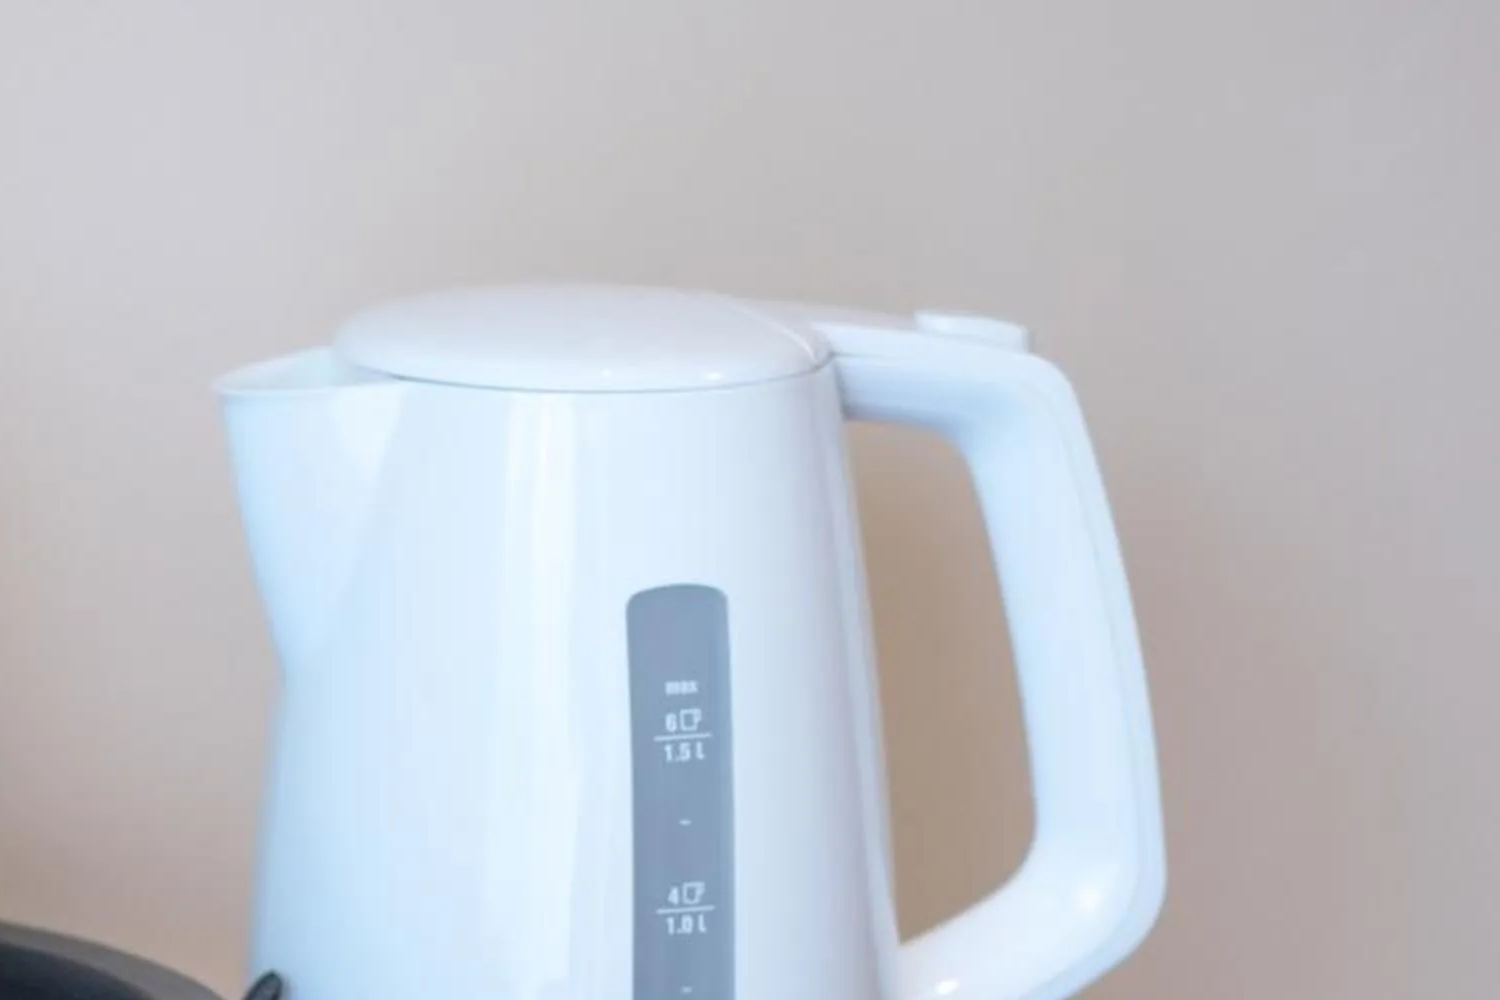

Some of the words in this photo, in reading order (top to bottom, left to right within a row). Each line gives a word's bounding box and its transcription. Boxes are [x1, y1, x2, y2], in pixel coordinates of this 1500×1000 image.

[665, 712, 678, 732] 6
[664, 742, 691, 761] 1.5
[668, 886, 679, 904] 4
[666, 914, 694, 936] 1.0
